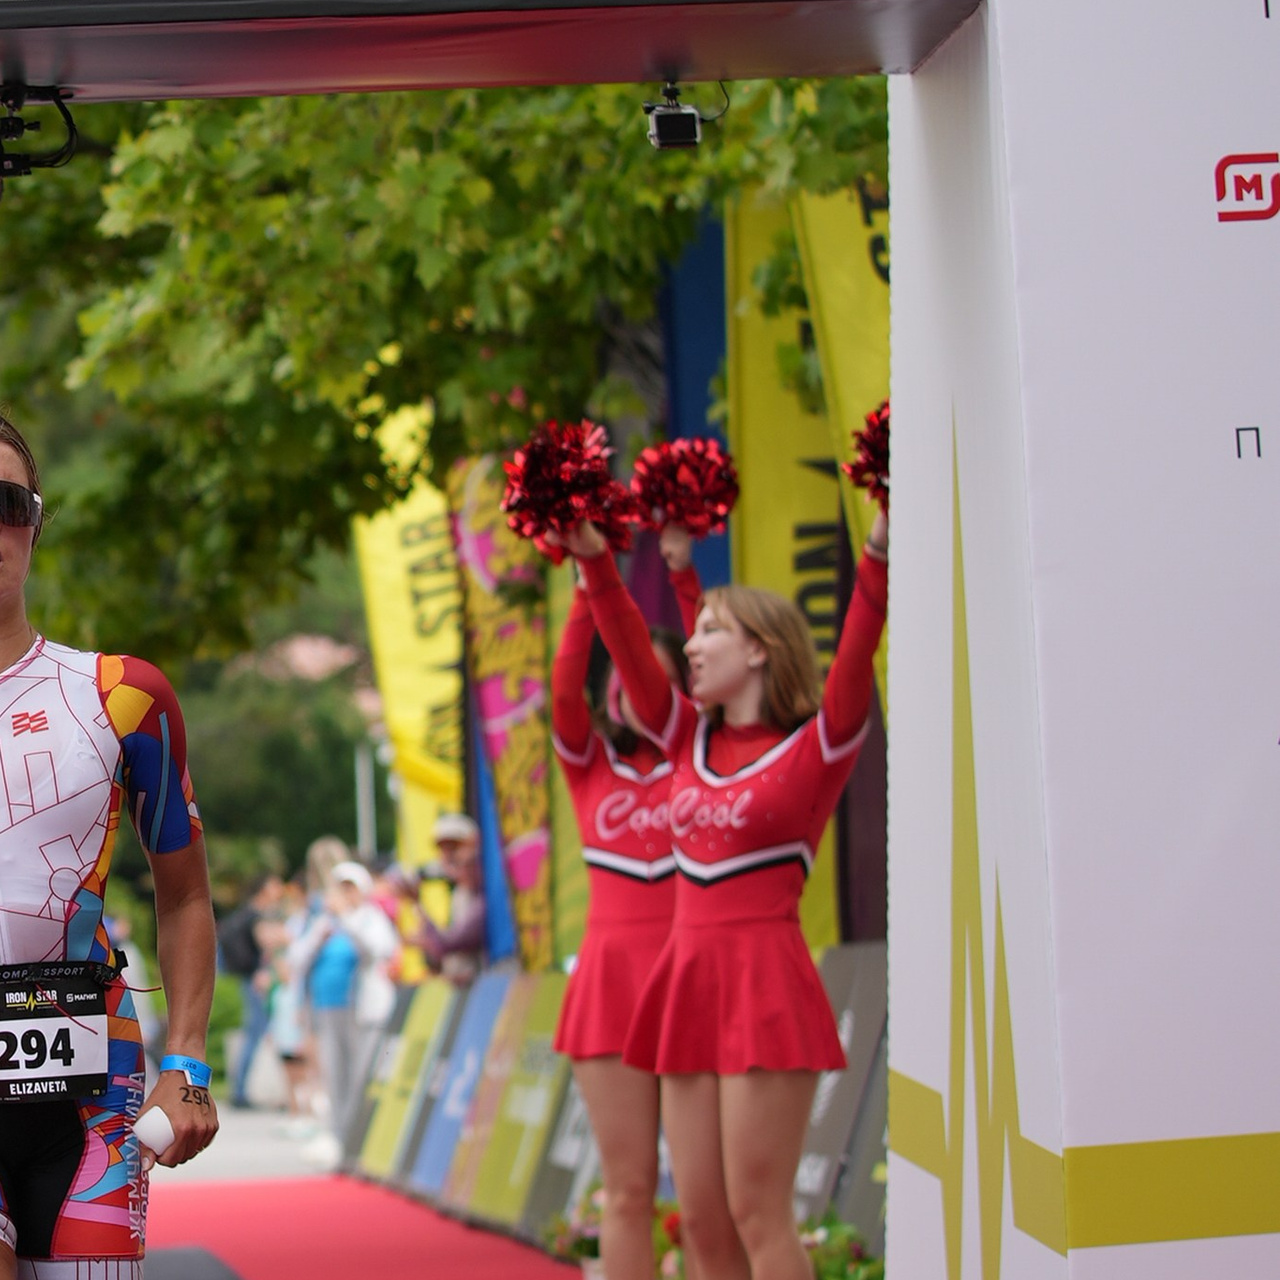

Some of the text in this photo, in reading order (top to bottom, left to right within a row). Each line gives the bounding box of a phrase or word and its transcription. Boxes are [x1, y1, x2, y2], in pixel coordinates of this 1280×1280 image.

[594, 789, 671, 842] Coo
[670, 786, 754, 838] Cool
[5, 991, 27, 1004] IRON
[9, 1080, 68, 1095] ELIZAVETA
[178, 1086, 210, 1108] 294
